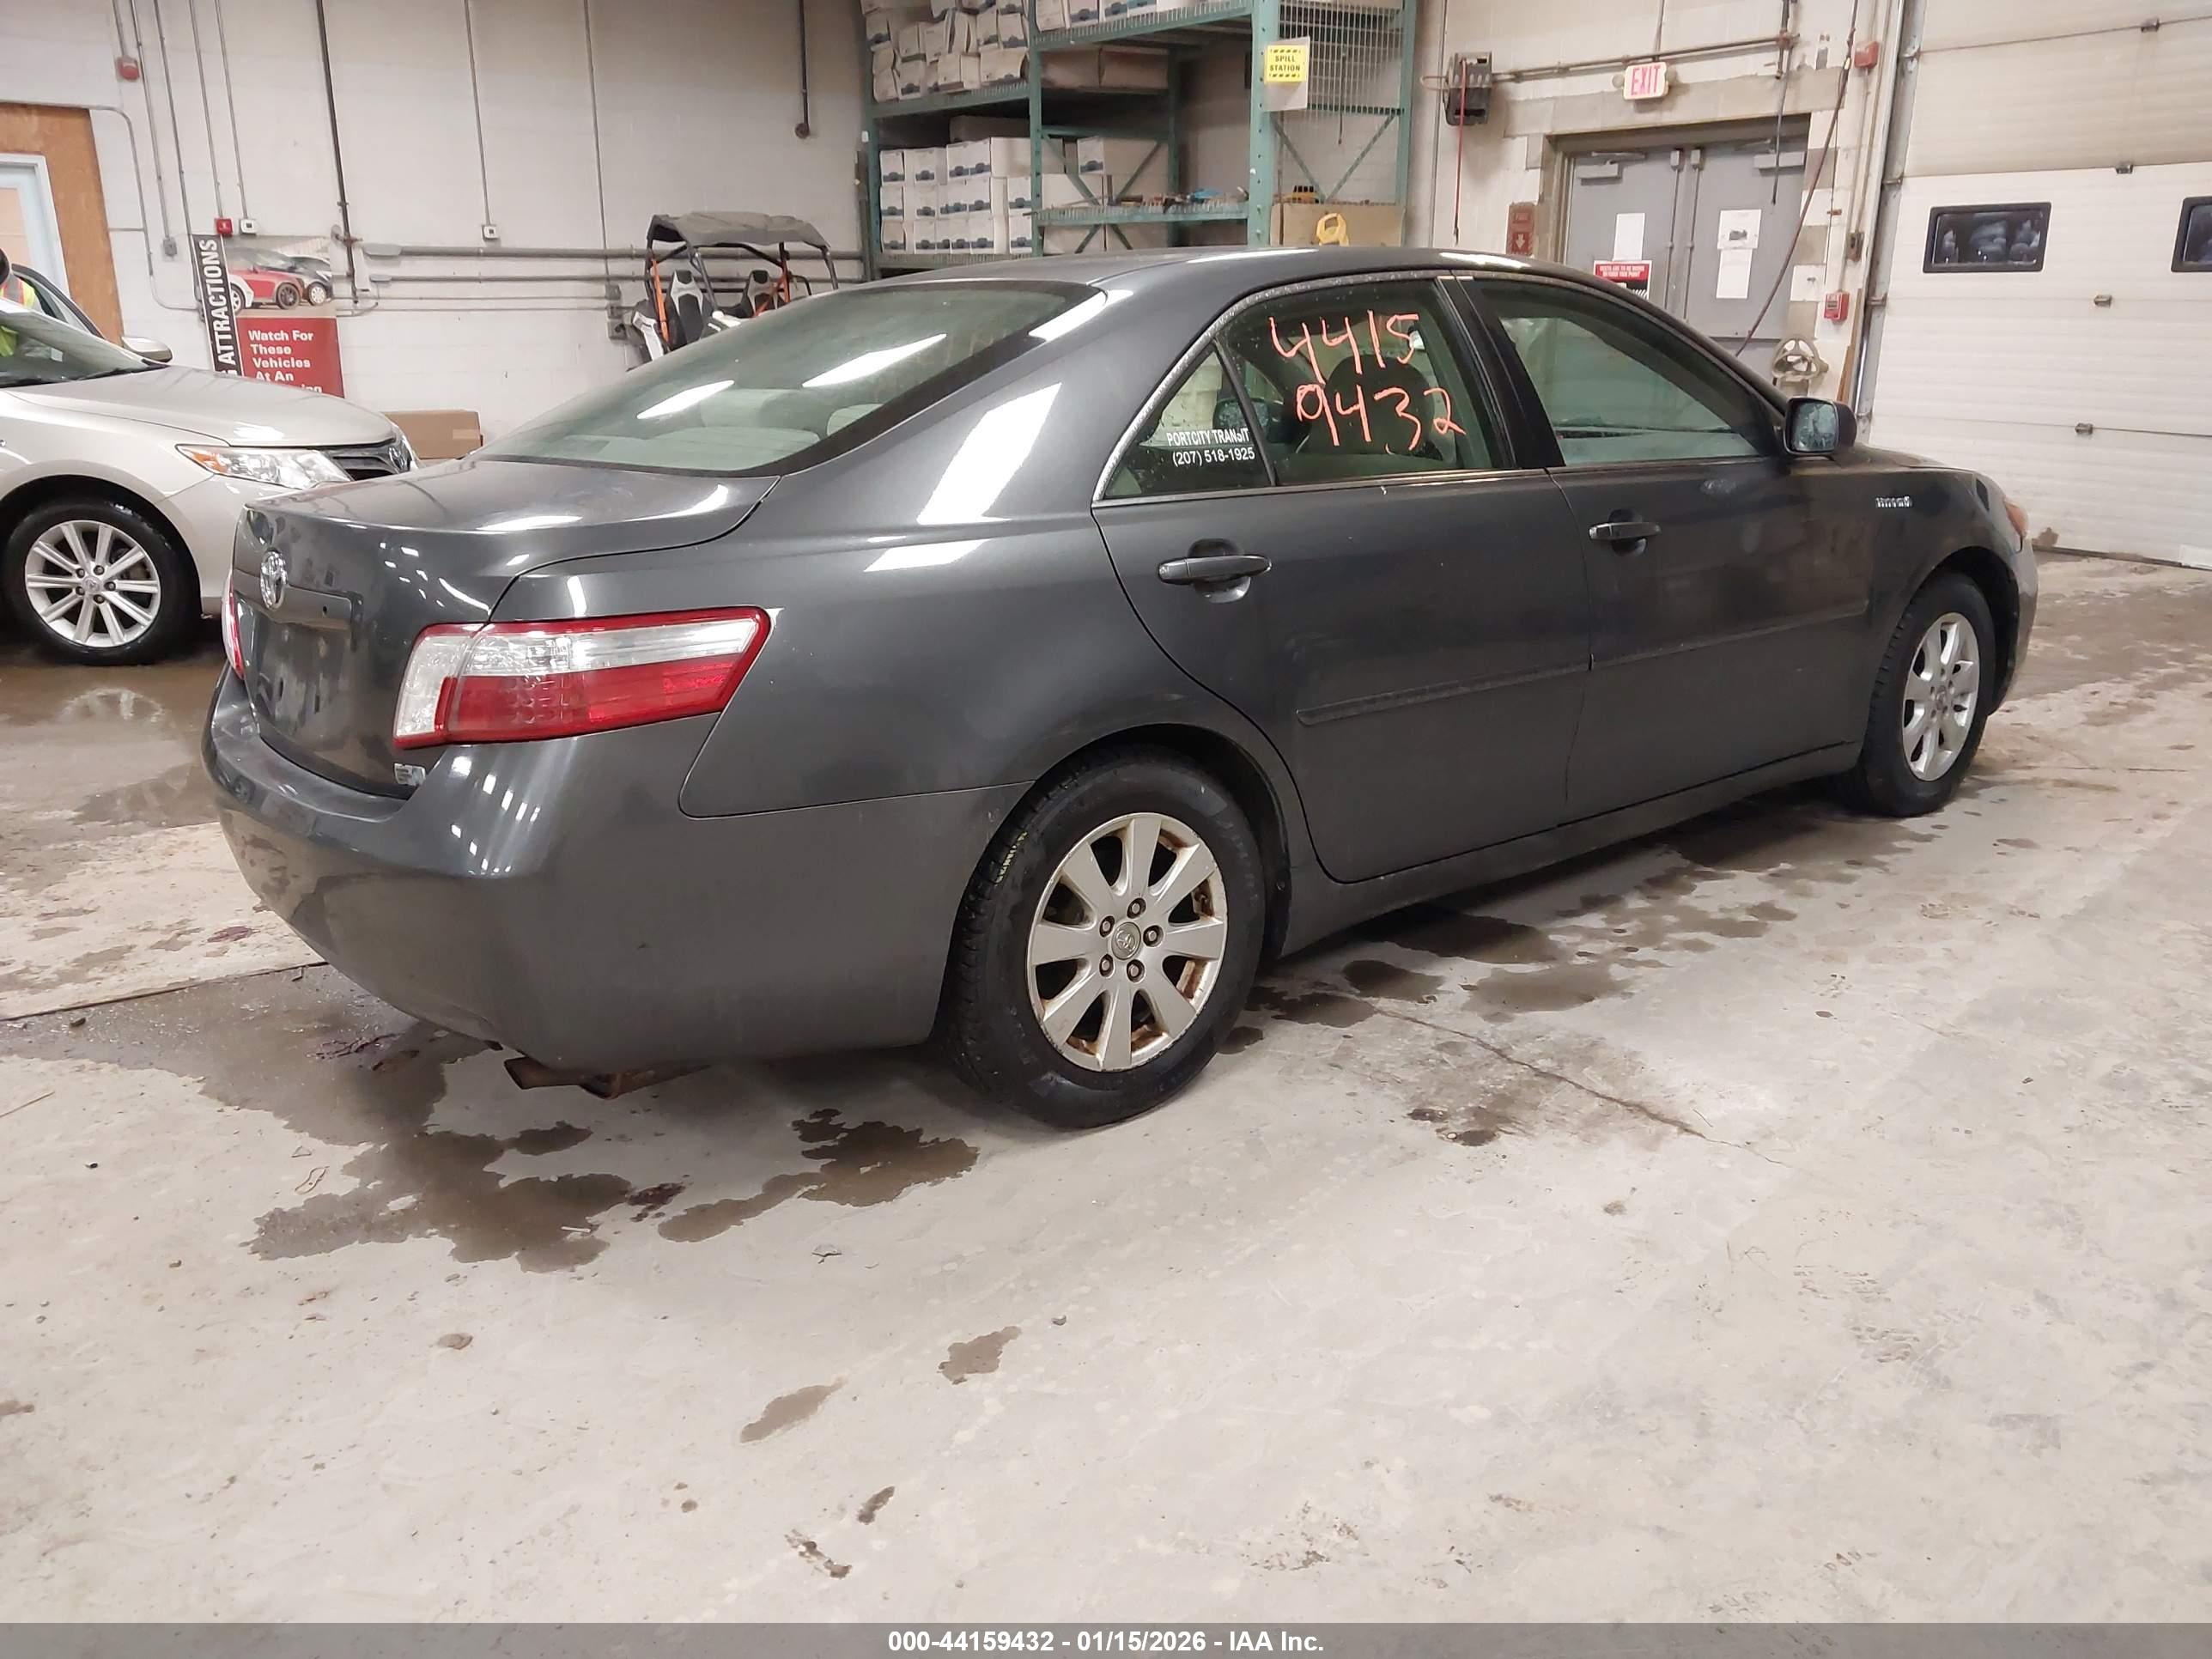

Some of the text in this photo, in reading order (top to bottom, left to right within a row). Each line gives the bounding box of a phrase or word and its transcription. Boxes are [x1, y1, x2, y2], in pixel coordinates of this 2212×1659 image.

[1631, 64, 1662, 95] EXIT
[198, 239, 237, 366] ATTRACTIONS
[248, 330, 314, 341] Watch For
[251, 343, 292, 355] These
[1268, 309, 1419, 385] 4415
[252, 357, 311, 368] Vehicles
[256, 371, 295, 382] At An
[1296, 384, 1467, 451] 9432
[1166, 429, 1212, 447] PORTCITY
[1172, 447, 1255, 467] (207) 518-1925
